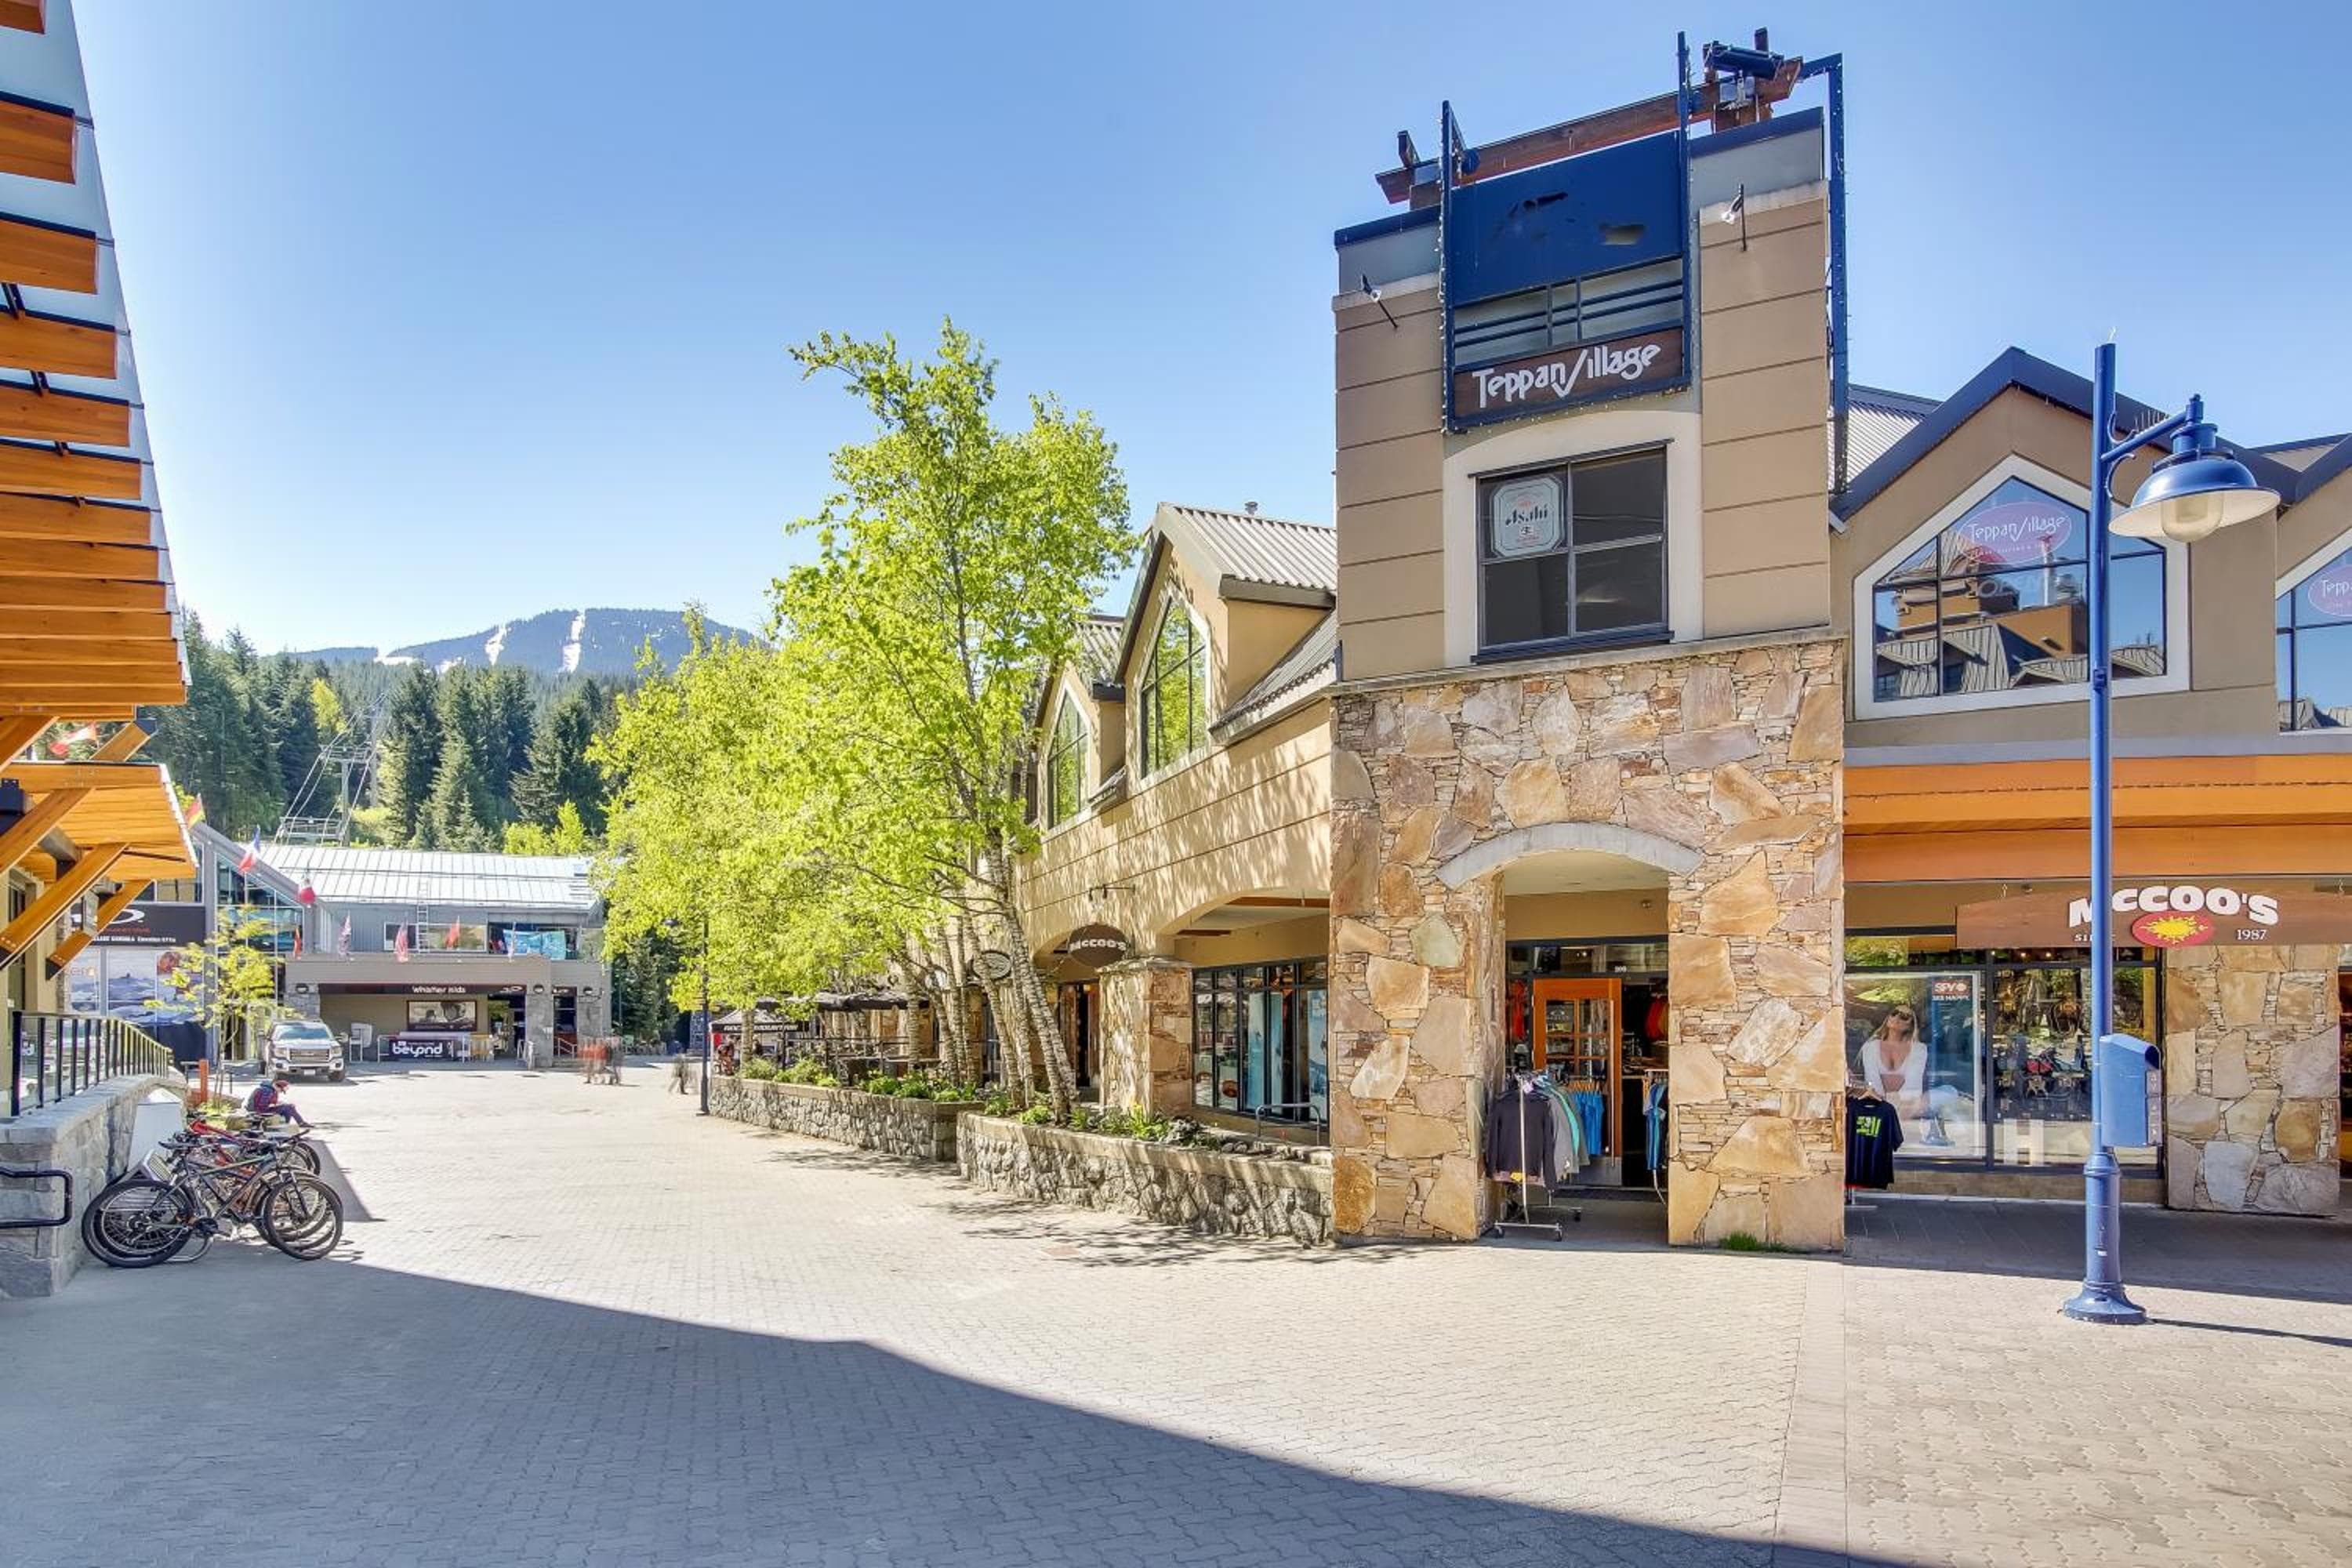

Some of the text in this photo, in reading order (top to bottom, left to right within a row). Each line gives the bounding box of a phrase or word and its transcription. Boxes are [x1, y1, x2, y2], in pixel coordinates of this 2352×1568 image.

[1505, 503, 1548, 526] Asahi
[2321, 579, 2352, 598] Tepp
[2237, 929, 2267, 941] 1987
[392, 1041, 443, 1058] beyond
